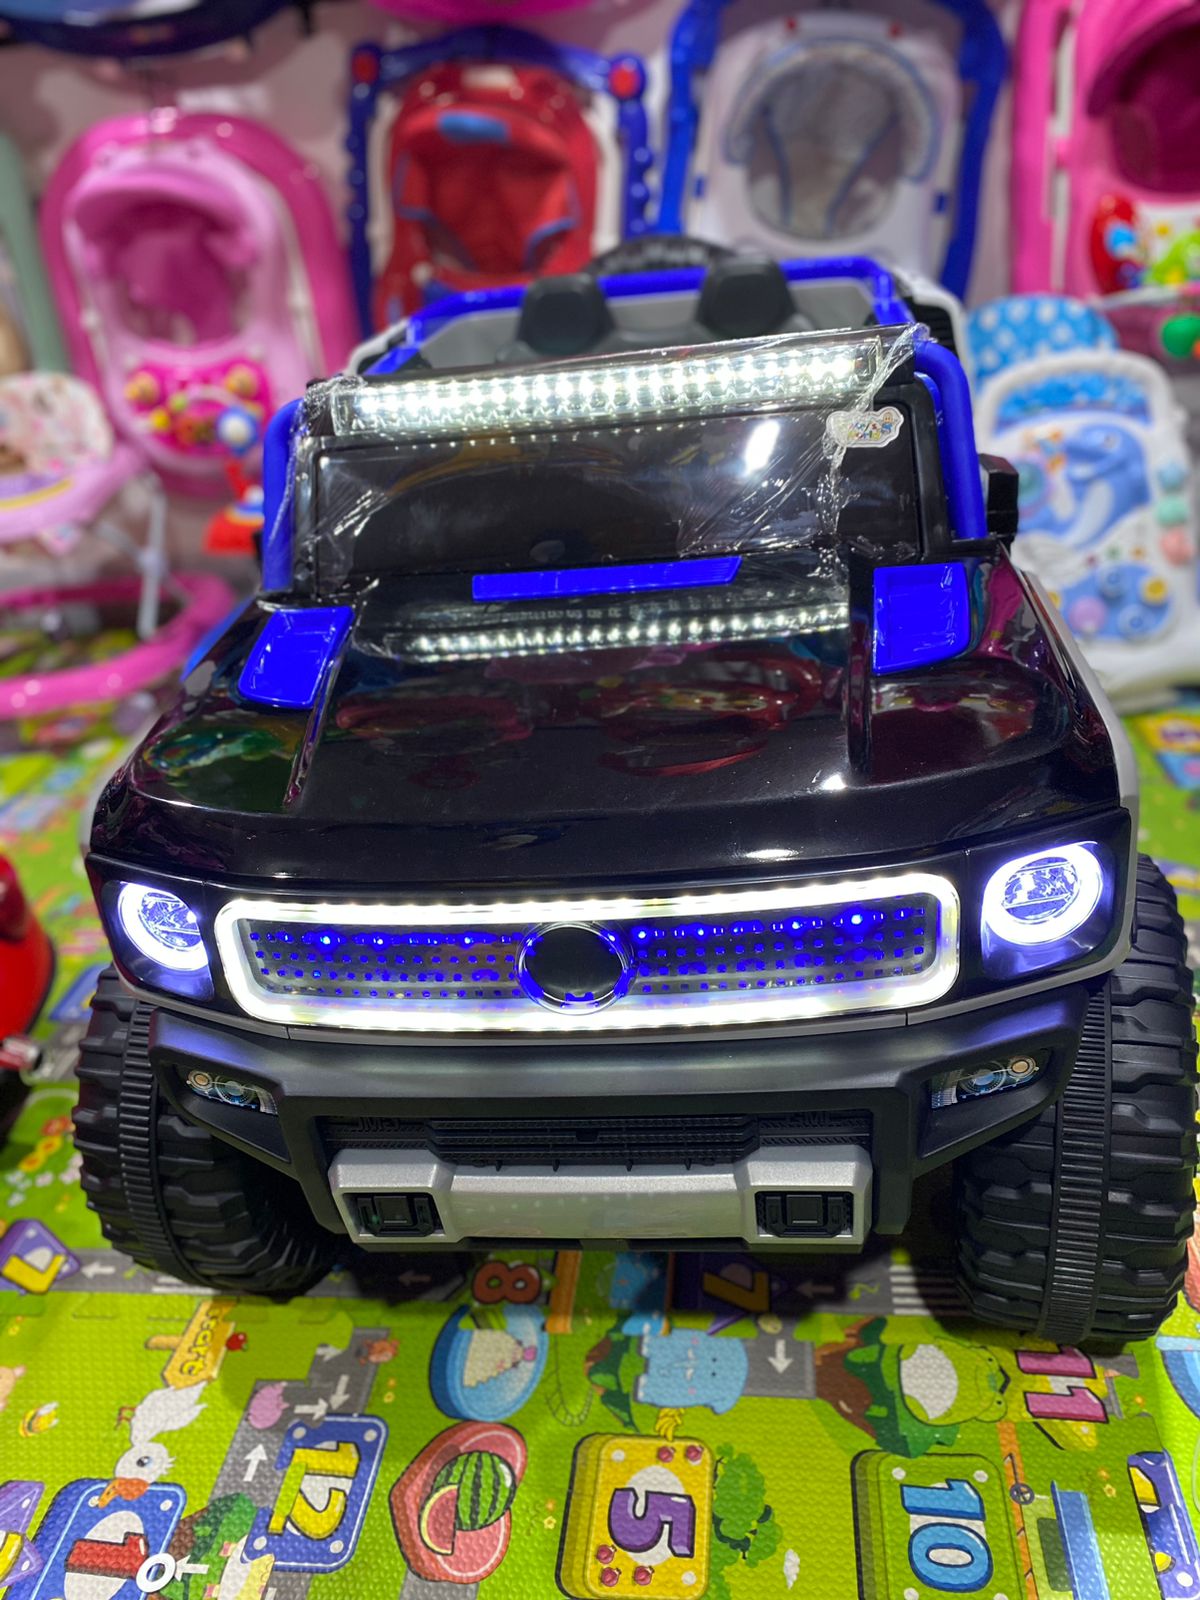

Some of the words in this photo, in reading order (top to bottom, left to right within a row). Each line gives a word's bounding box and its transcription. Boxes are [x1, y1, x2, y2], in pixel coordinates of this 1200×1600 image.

[470, 1261, 542, 1304] 8
[1014, 1343, 1109, 1424] 11
[268, 1441, 361, 1539] 12
[607, 1487, 696, 1559] 5
[64, 1531, 150, 1580] 1
[901, 1478, 993, 1591] 10
